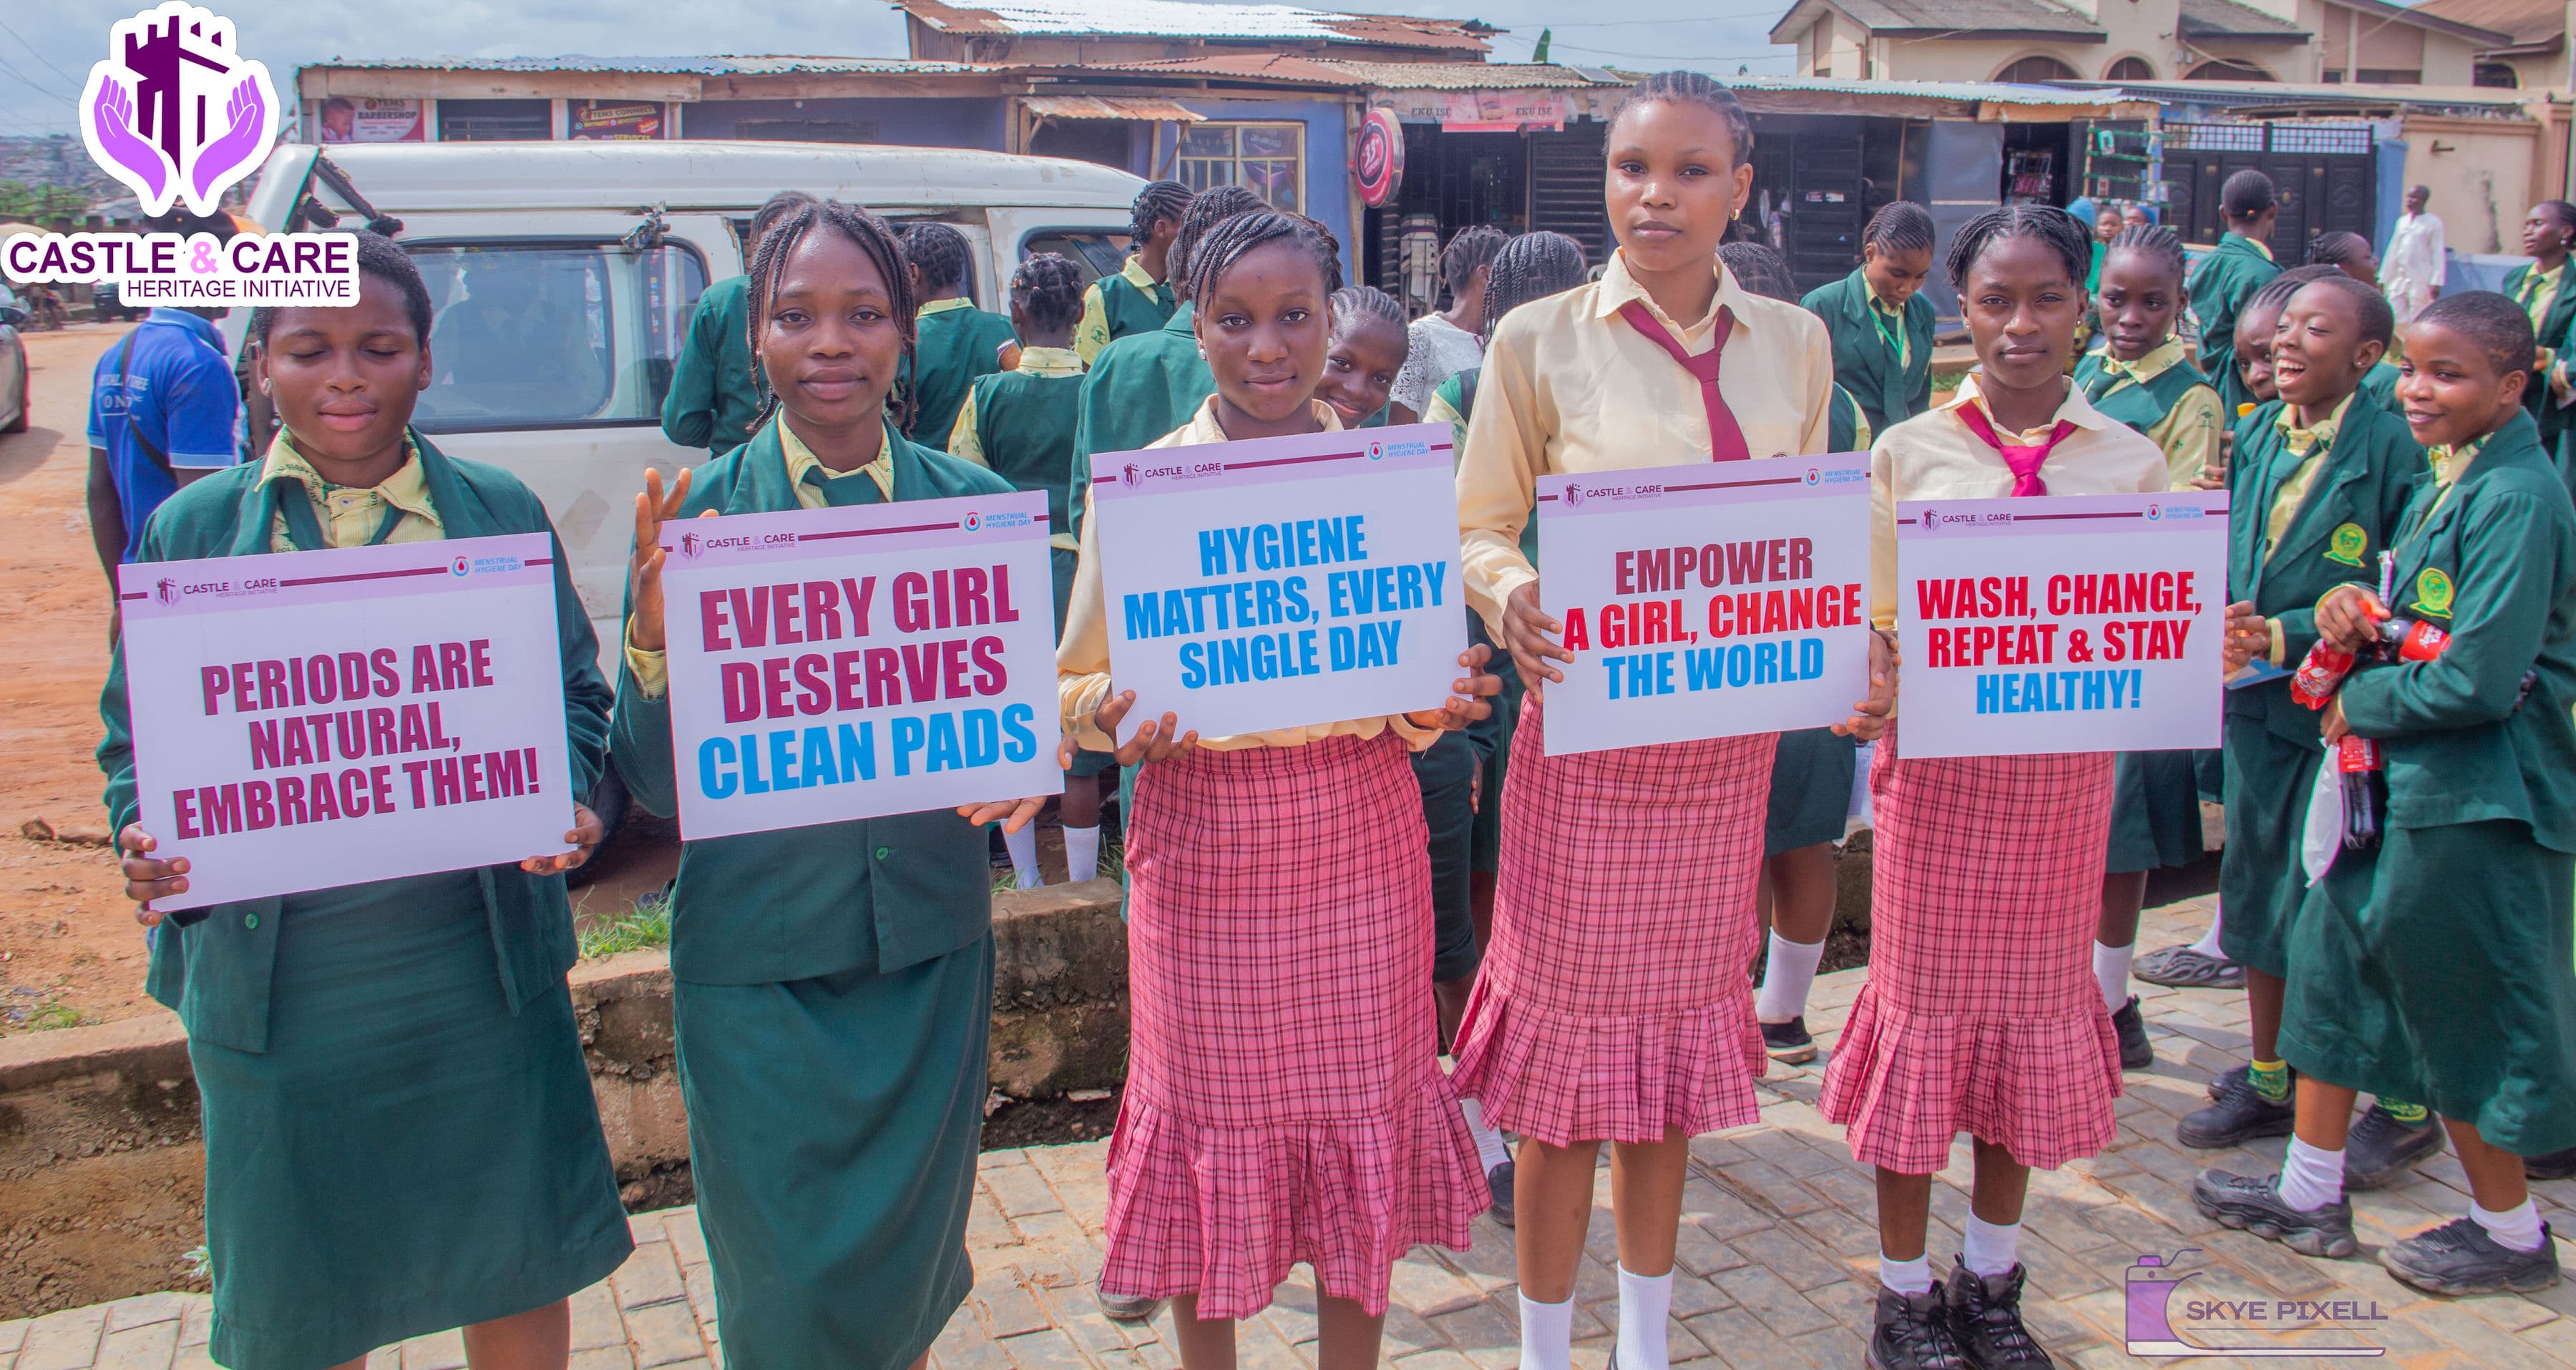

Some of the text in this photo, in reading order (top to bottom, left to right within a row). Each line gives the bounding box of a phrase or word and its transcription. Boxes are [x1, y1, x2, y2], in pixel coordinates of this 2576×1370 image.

[358, 111, 416, 119] BARBERSHOP
[615, 106, 653, 116] CONNECT
[1145, 466, 1183, 477] CASTLE
[1194, 463, 1221, 472] CARE
[1388, 441, 1425, 450] MENSTRUAL
[985, 512, 1028, 521] MENSTRUAL
[1586, 488, 1623, 497] CASTLE
[1635, 485, 1662, 494] CARE
[474, 557, 518, 566] MENSTRUAL
[706, 537, 751, 548] CASTLE
[764, 533, 796, 544] CARE
[1199, 515, 1367, 576] HYGIENE
[1616, 537, 1813, 595] EMPOWER
[184, 582, 230, 595] CASTLE
[245, 578, 277, 589] CARE
[700, 564, 1019, 652] EVERY GIRL
[1123, 561, 1447, 640] MATTERS, EVERY
[1917, 572, 2202, 620] WASH, CHANGE,
[1563, 583, 1861, 652] A GIRL, CHANGE
[1929, 620, 2191, 667] REPEAT & STAY
[201, 639, 494, 715] PERIODS ARE
[721, 635, 1008, 723] DESERVES
[1180, 620, 1402, 689] SINGLE DAY
[1603, 638, 1824, 700] THE WORLD
[1976, 669, 2142, 714] HEALTHY!
[248, 702, 461, 770] NATURAL,
[698, 703, 1037, 800] CLEAN PADS
[173, 747, 540, 840] EMBRACE THEM!
